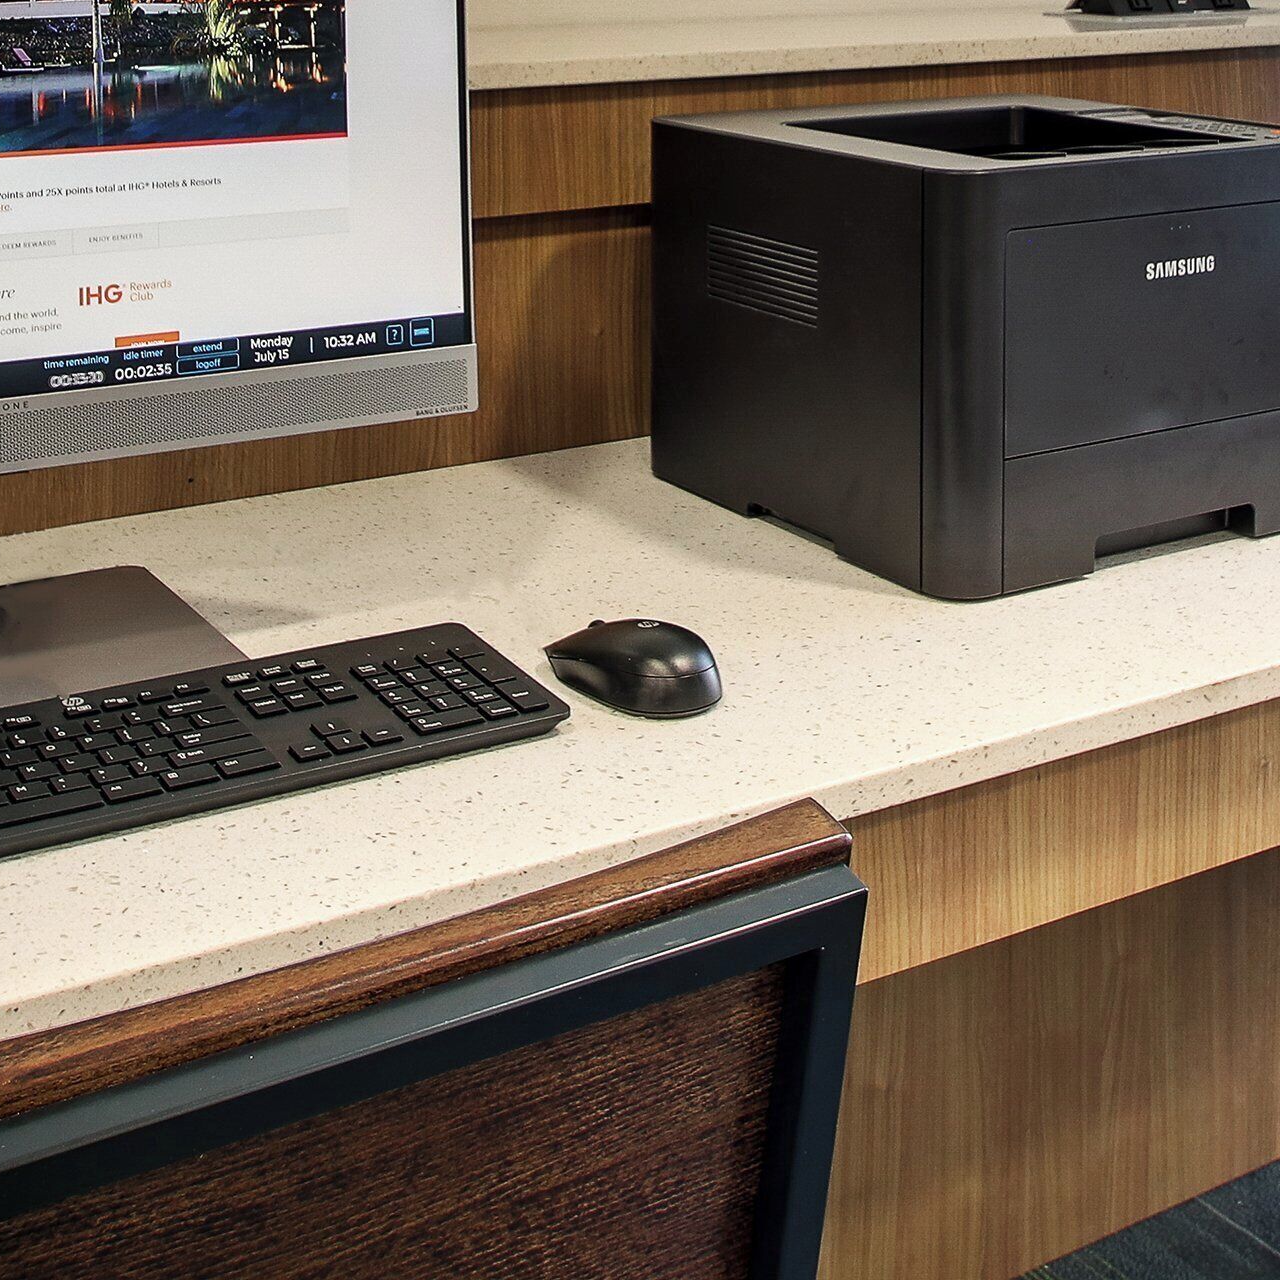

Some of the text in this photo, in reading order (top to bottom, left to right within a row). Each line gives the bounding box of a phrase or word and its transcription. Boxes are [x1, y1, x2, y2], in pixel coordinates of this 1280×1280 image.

[26, 188, 43, 198] and
[46, 187, 63, 197] 25X
[65, 186, 94, 196] points
[95, 183, 116, 193] total
[117, 183, 126, 192] at
[151, 179, 180, 189] Hotels
[181, 178, 188, 187] &
[189, 177, 222, 187] Resorts
[1145, 255, 1216, 281] SAMSUNG
[129, 279, 172, 291] Rewards
[79, 283, 123, 306] IHG
[129, 291, 154, 302] Club
[13, 311, 28, 320] the
[31, 322, 62, 333] inspire
[323, 331, 378, 349] 10:32 AM
[391, 329, 398, 340] ?
[192, 341, 224, 354] extend
[250, 334, 294, 350] Monday
[140, 349, 164, 359] timer
[253, 349, 290, 363] July 15
[44, 354, 110, 370] time remaining
[195, 358, 222, 370] logoff
[115, 363, 172, 381] 00:02:35
